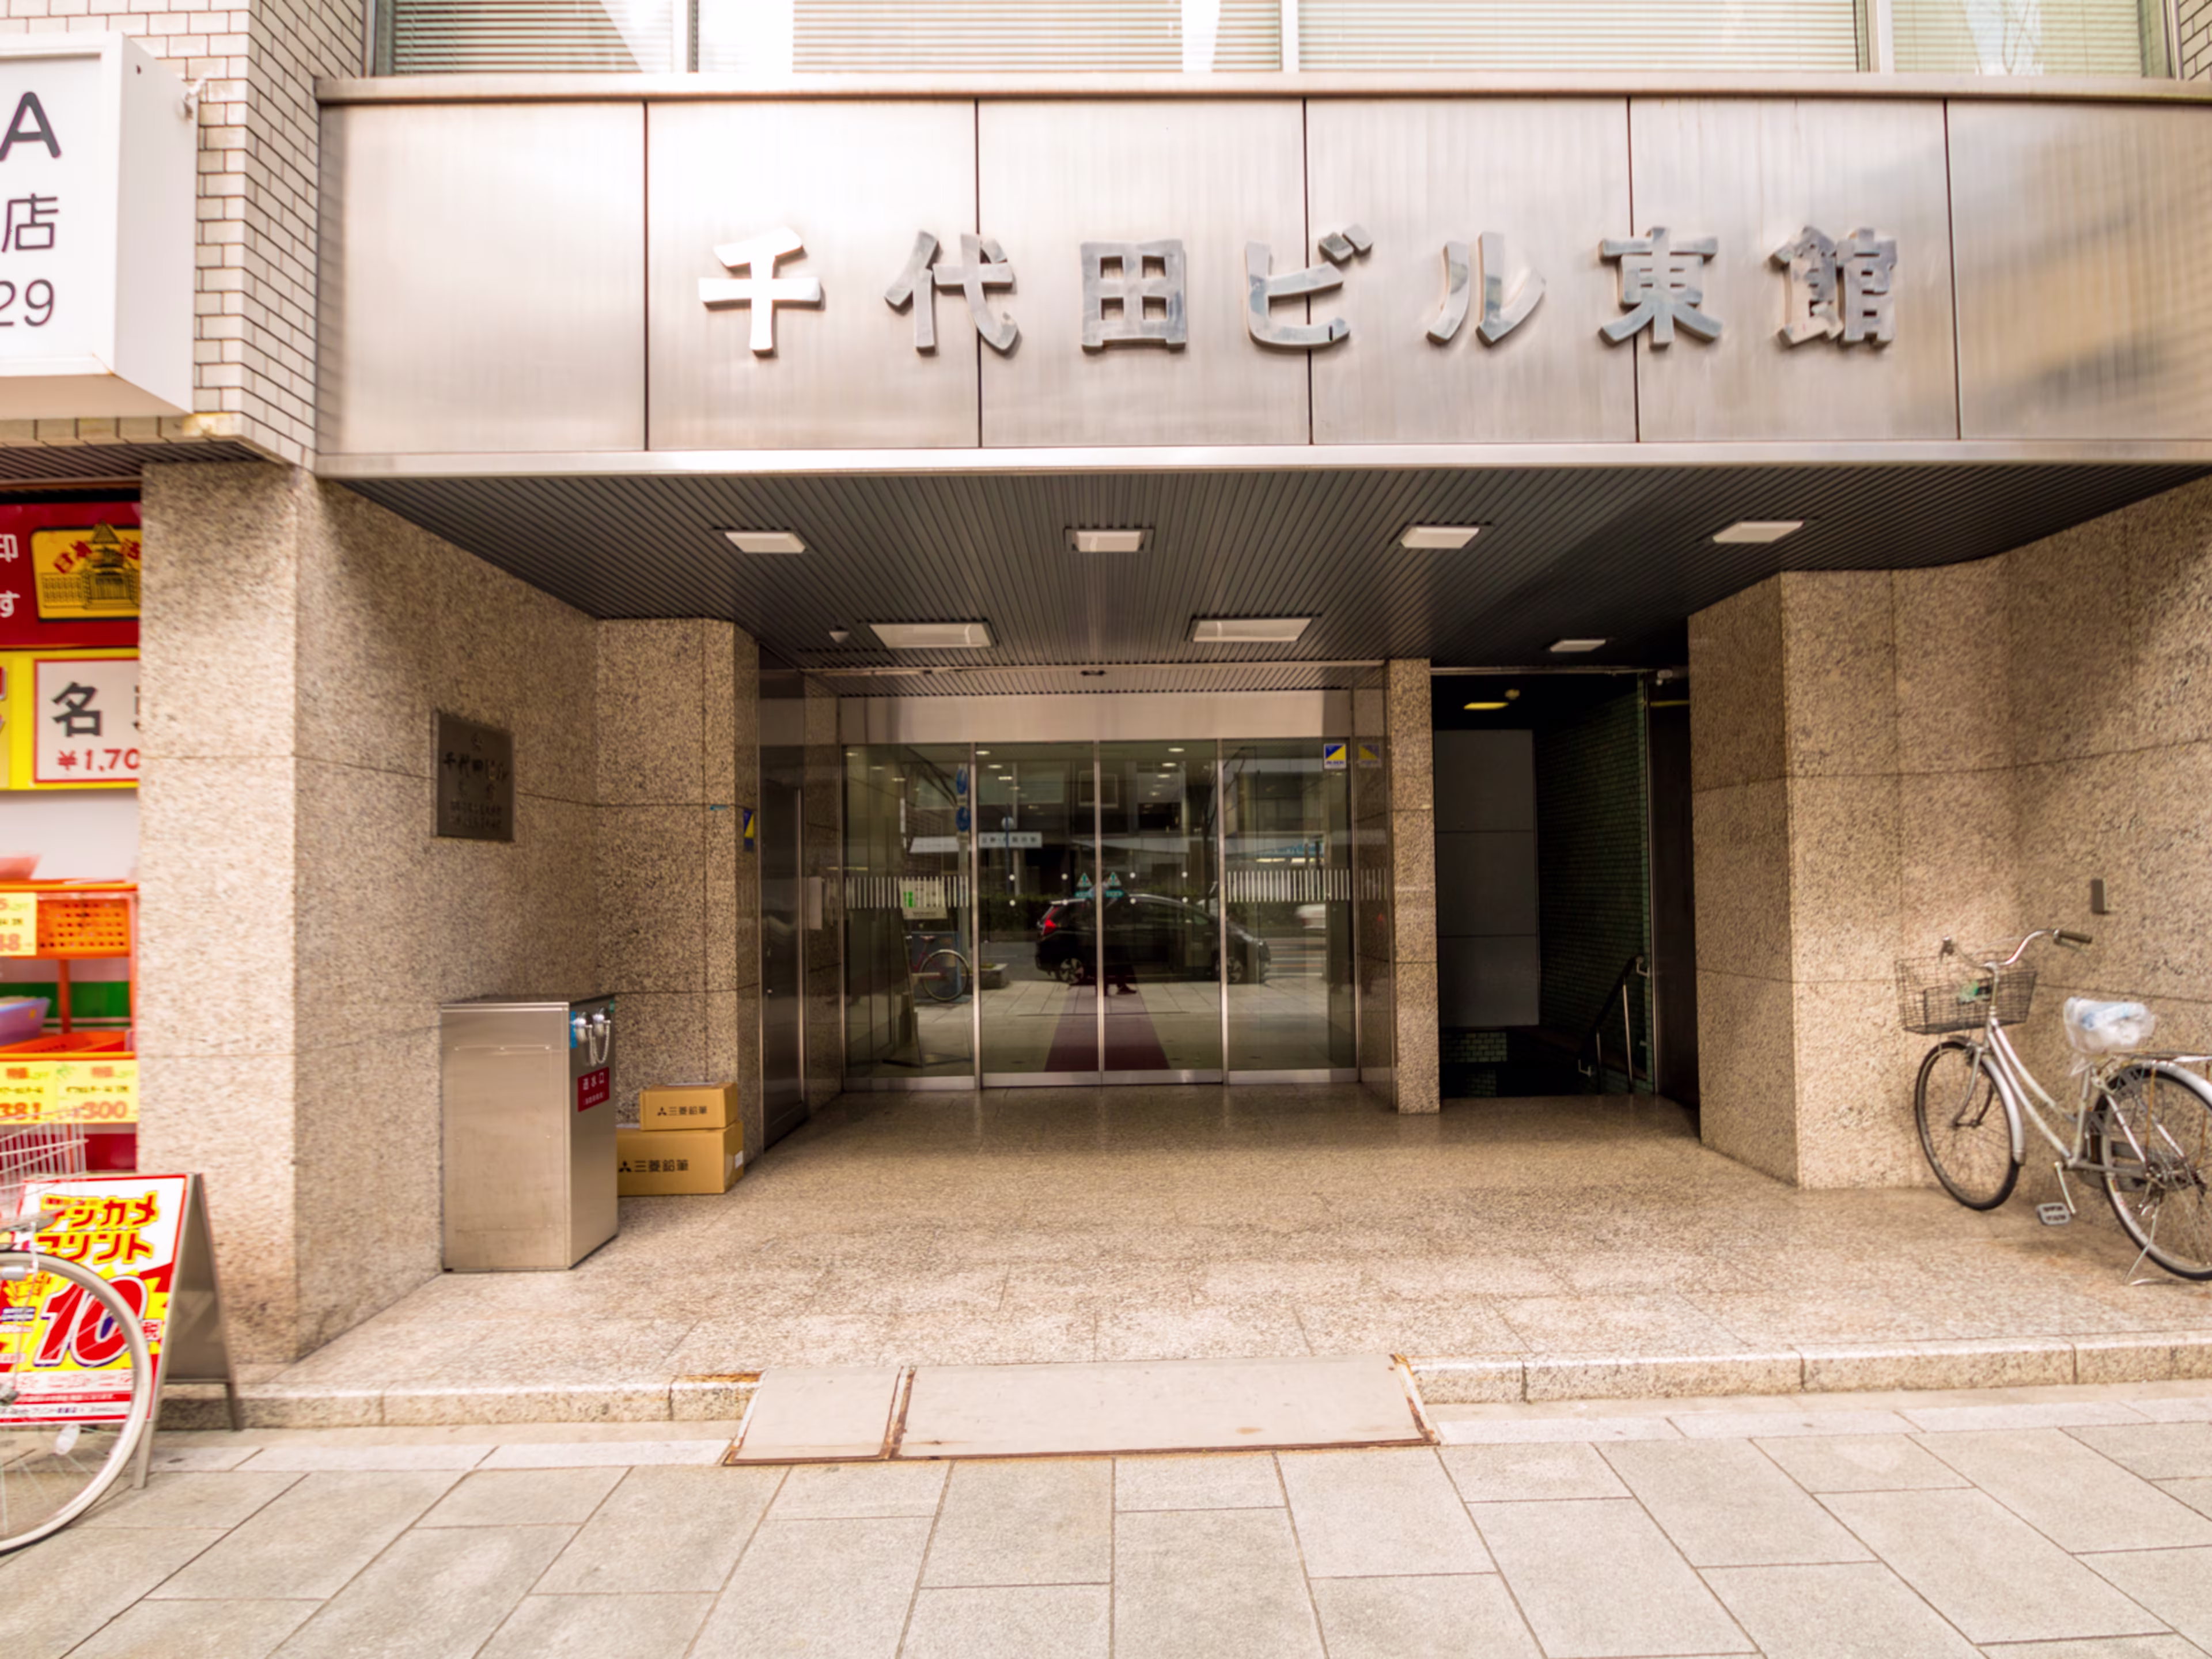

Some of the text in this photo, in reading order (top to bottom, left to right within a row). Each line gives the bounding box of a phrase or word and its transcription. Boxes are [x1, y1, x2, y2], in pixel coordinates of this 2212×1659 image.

[0, 91, 61, 161] A
[2, 194, 59, 252] 店
[699, 226, 1897, 355] 千代田ビル東館
[634, 1158, 688, 1173] 三菱鉛筆
